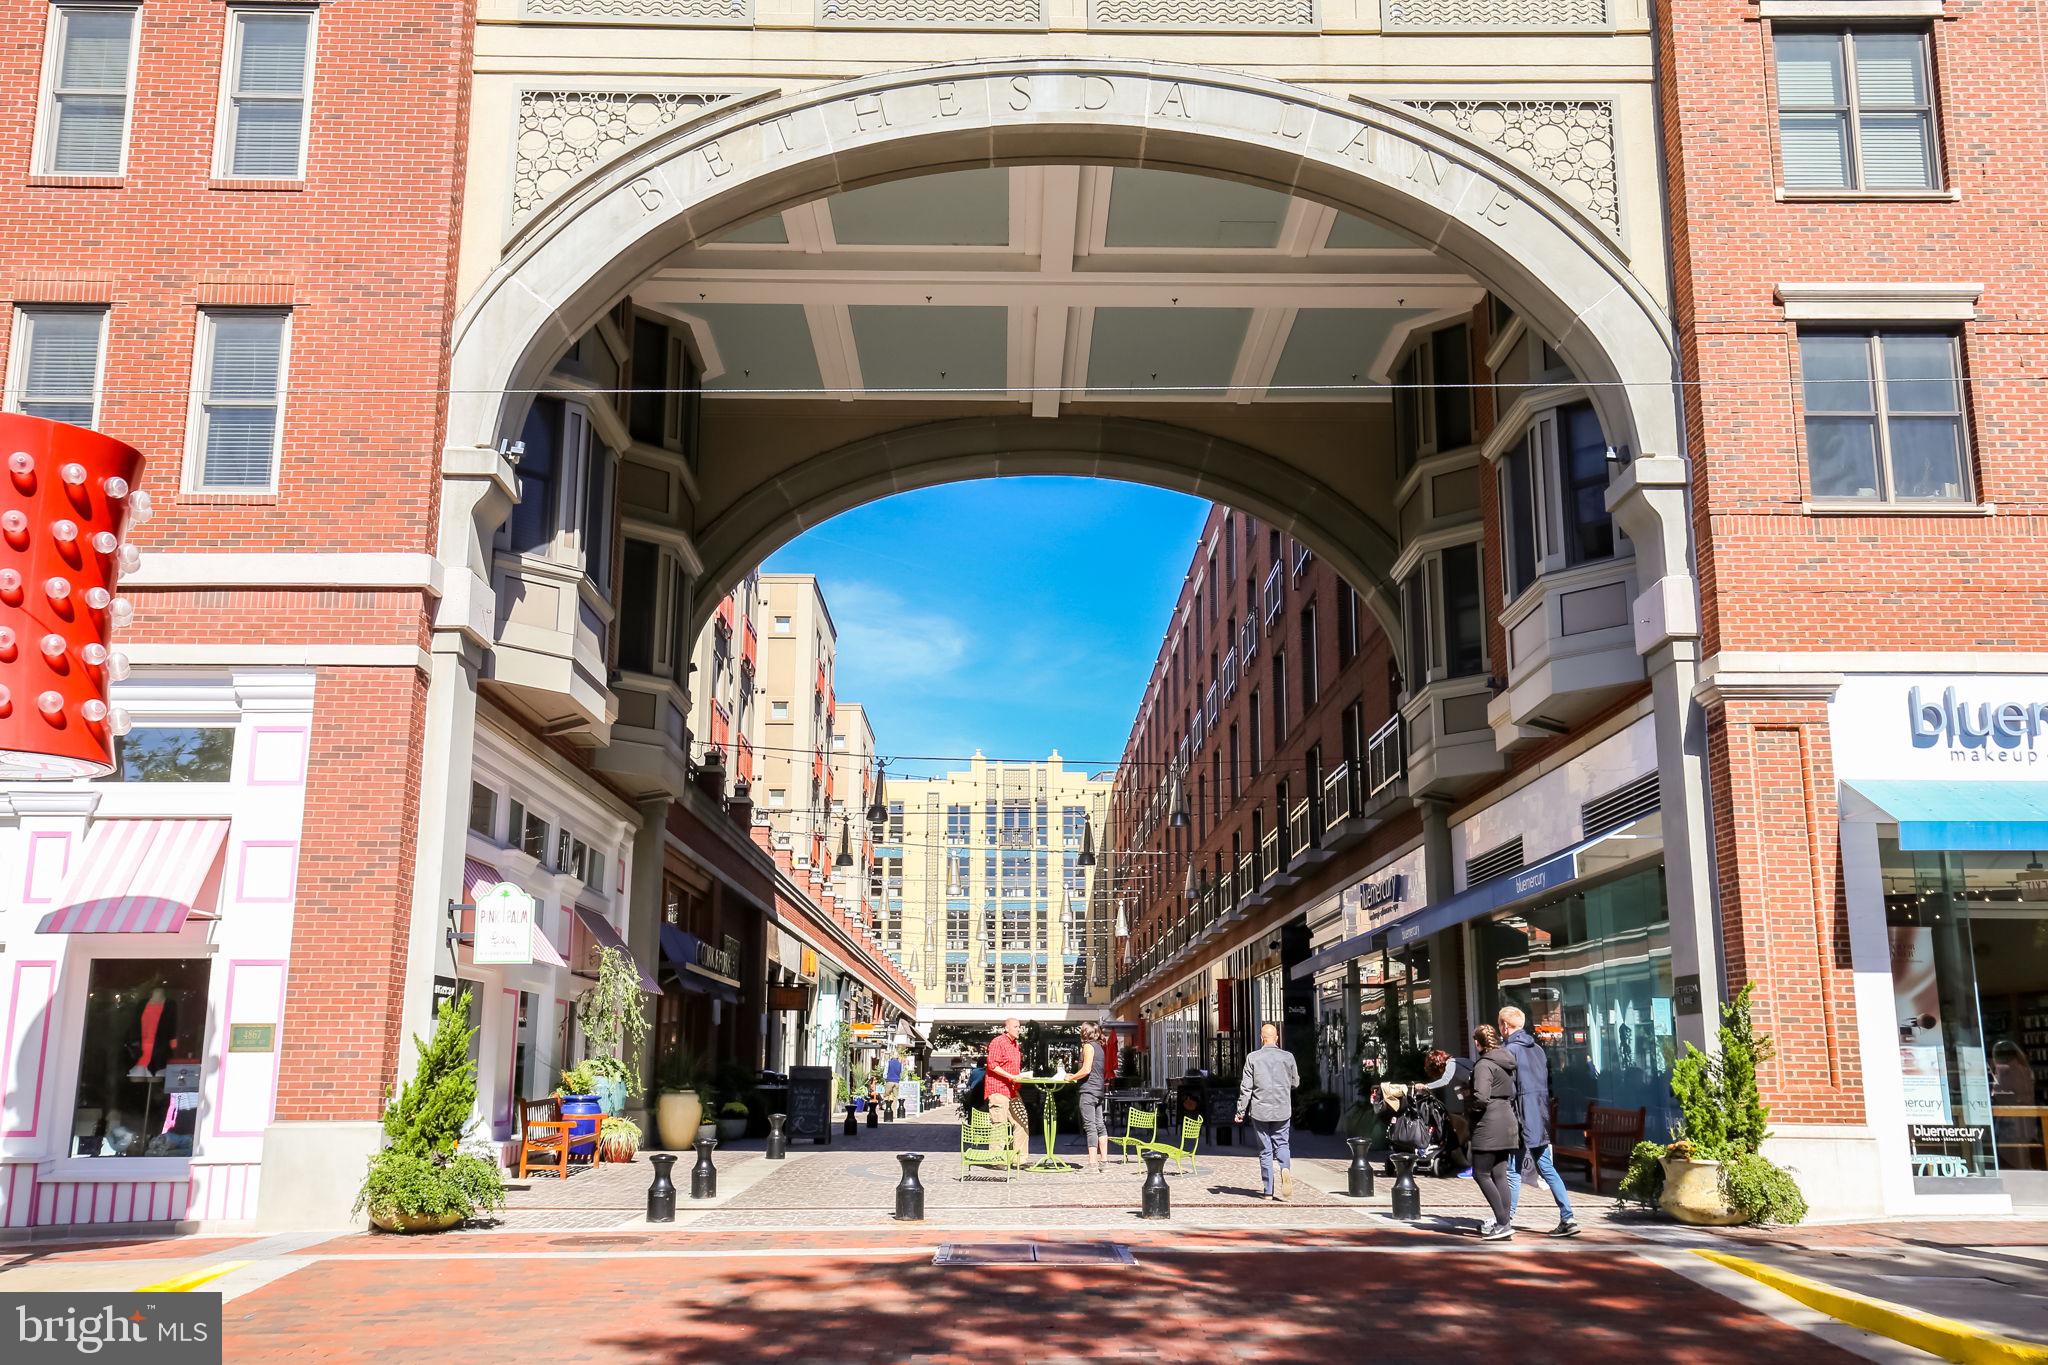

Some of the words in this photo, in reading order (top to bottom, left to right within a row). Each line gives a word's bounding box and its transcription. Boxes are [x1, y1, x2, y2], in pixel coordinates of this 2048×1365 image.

[621, 74, 1192, 218] BETHESDA
[1272, 99, 1520, 227] LANE
[1950, 750, 2038, 766] makeup
[1360, 875, 1396, 910] bluemercury
[1516, 872, 1546, 893] bluemercury
[1913, 1124, 1984, 1140] bluemercury
